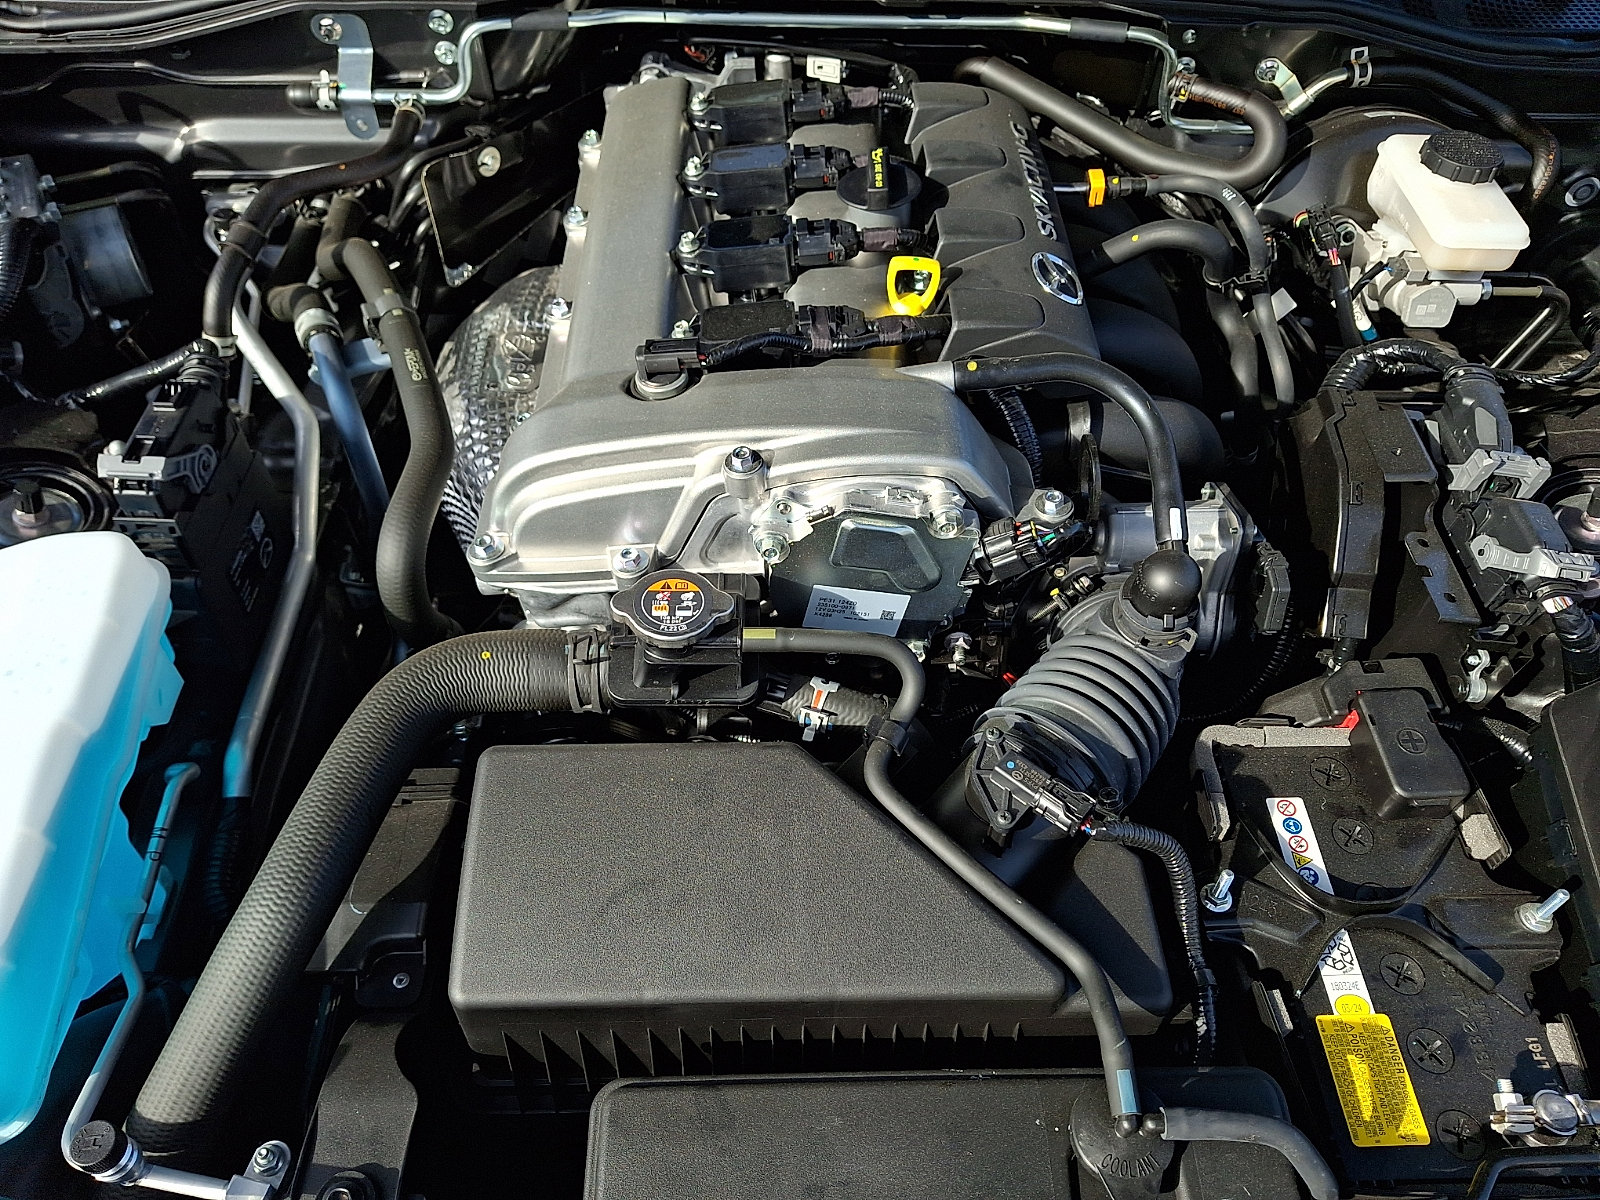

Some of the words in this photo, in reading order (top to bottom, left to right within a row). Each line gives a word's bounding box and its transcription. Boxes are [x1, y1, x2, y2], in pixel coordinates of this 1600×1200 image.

[1009, 120, 1058, 241] SKYACTIV-G
[1349, 1033, 1366, 1065] POISON
[1384, 1035, 1405, 1074] DANGER
[1100, 1151, 1161, 1178] COOLANT
